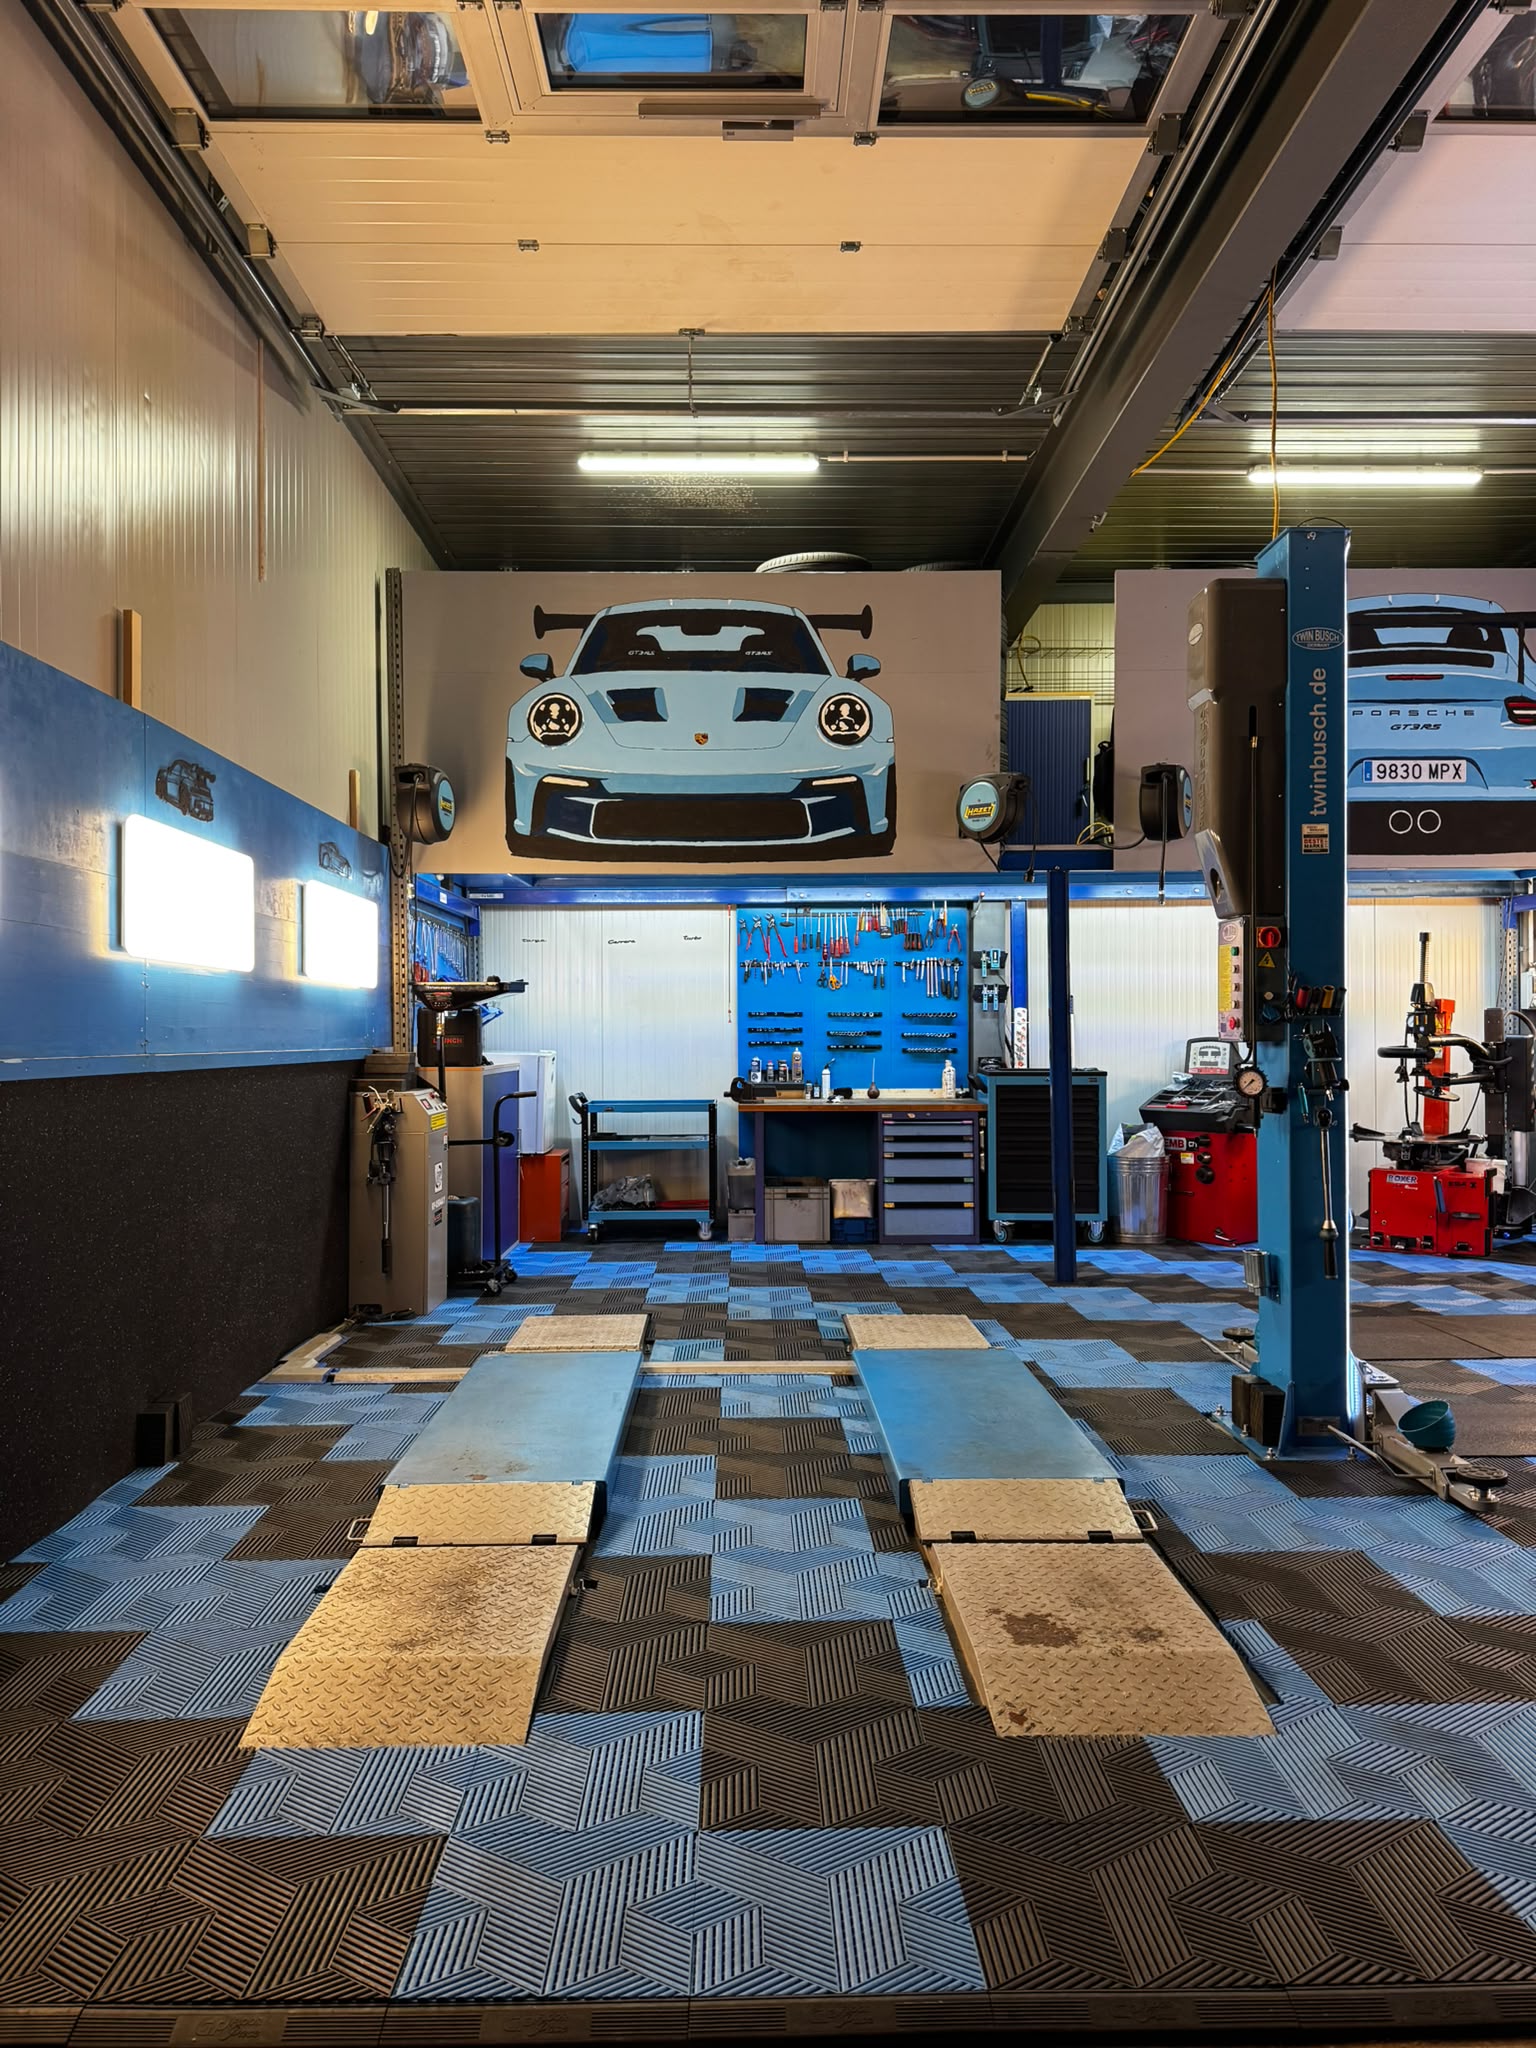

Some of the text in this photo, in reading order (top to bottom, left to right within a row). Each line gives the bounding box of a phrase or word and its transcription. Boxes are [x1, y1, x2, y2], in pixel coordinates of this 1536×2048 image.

[1296, 629, 1340, 641] TWIN BUSCH
[1352, 709, 1475, 717] PORSCHE
[1390, 723, 1442, 731] GT3RS
[1309, 667, 1328, 817] twinbusch.de
[1376, 763, 1423, 780] 9830
[1428, 763, 1462, 780] MPX
[967, 806, 993, 816] HAZET
[1387, 1174, 1418, 1184] BOXER
